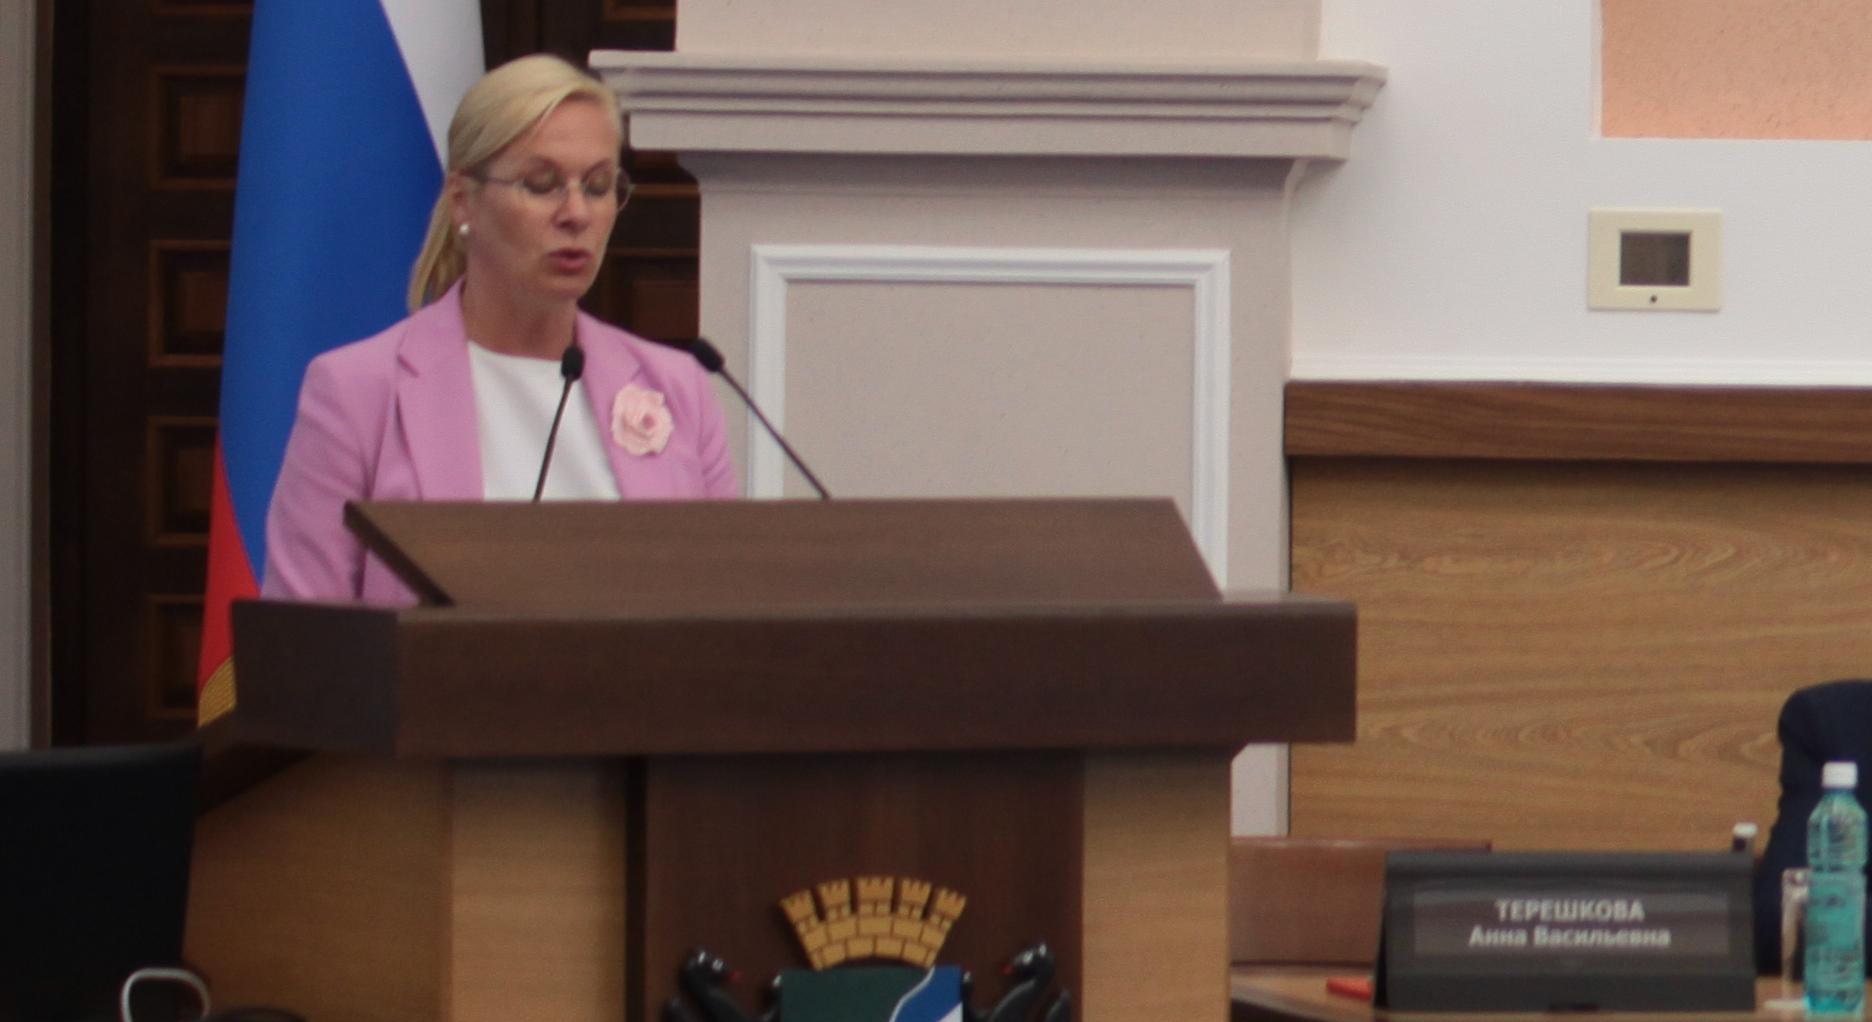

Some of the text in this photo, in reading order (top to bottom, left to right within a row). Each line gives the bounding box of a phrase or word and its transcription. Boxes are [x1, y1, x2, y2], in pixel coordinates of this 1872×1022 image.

[1495, 898, 1645, 922] ТЕРЕШКОВА
[1468, 924, 1672, 948] Анна Васильевна
